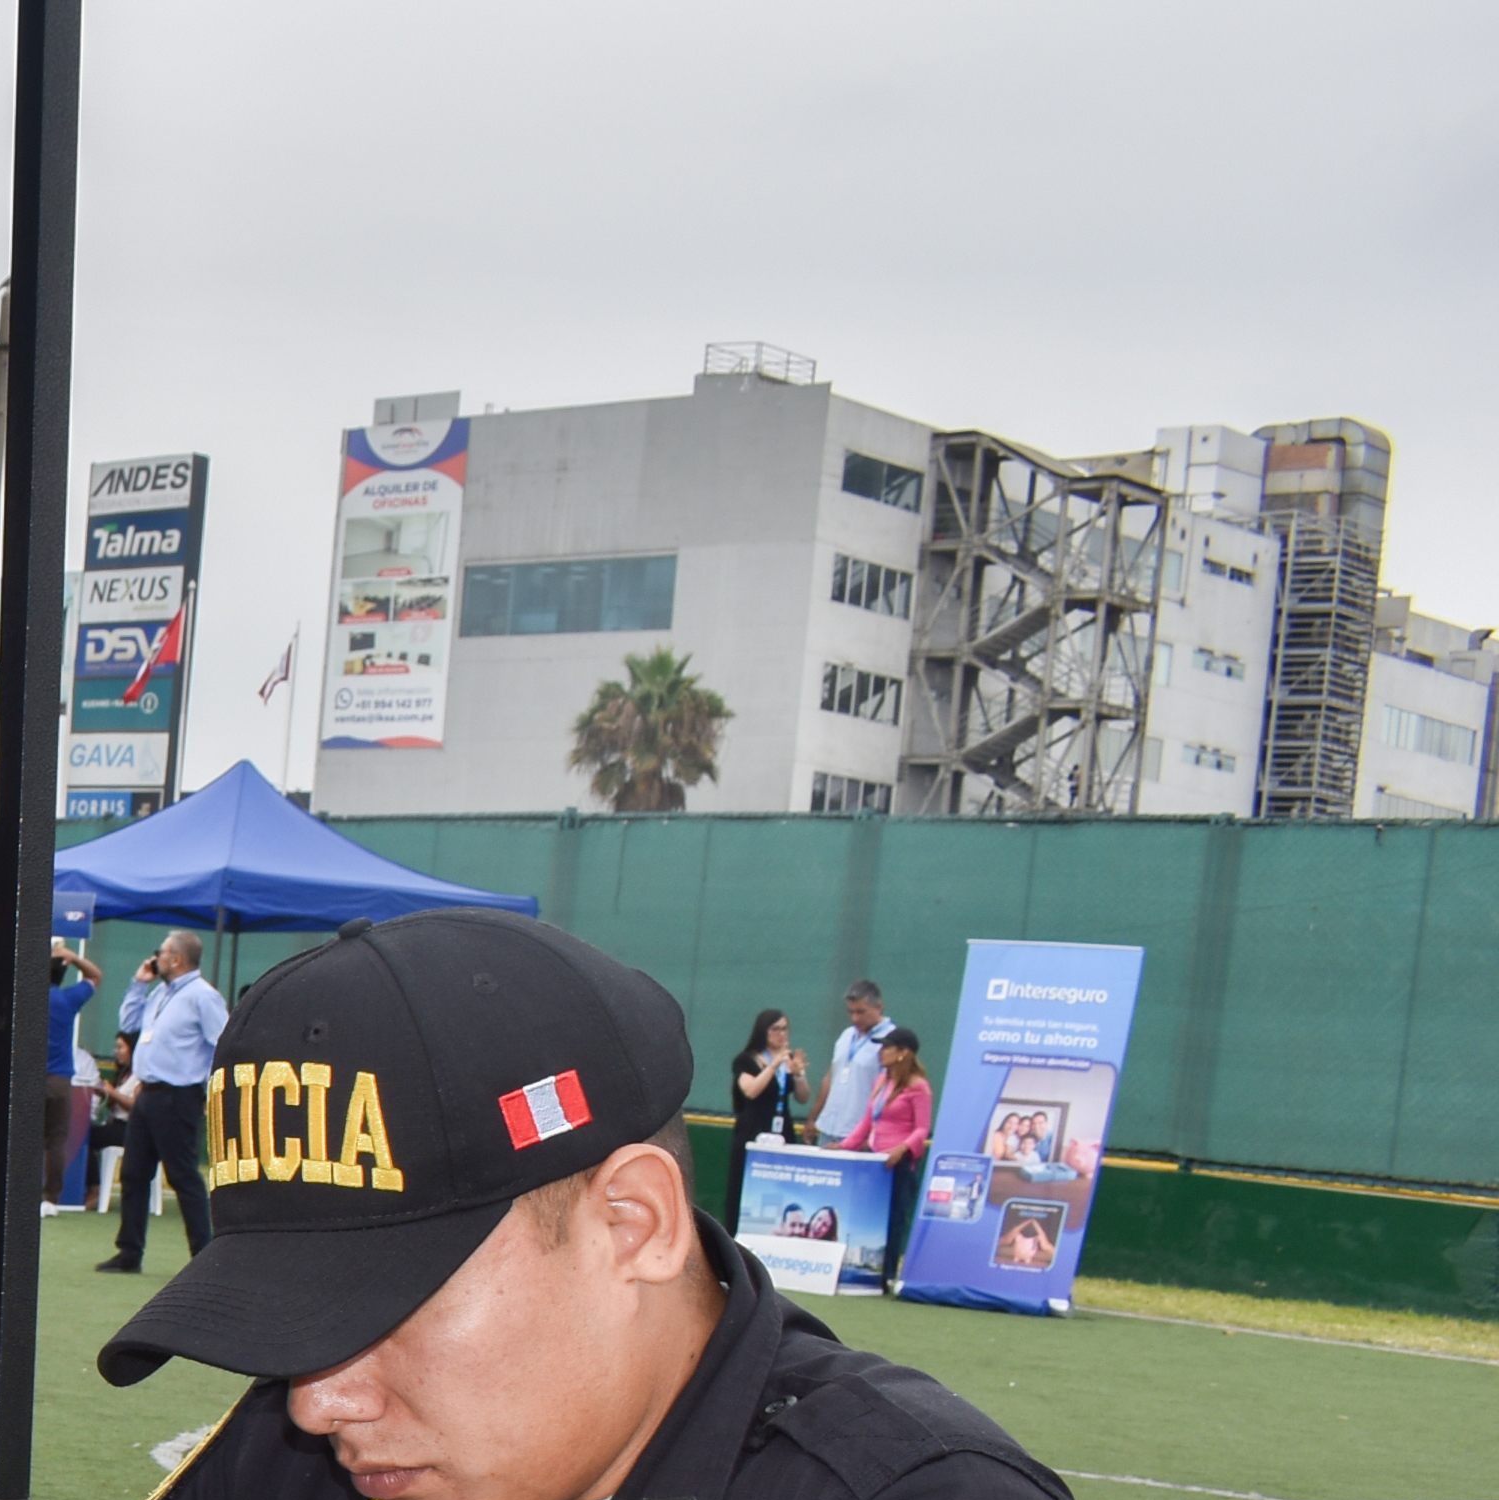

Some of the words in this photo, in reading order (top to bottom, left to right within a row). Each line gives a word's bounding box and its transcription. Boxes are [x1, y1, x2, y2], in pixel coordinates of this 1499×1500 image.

[92, 462, 190, 497] ANDES
[363, 482, 420, 497] ALQUILER
[423, 480, 438, 491] DE
[372, 496, 428, 510] OFICINAS
[93, 524, 181, 559] Talma
[89, 575, 171, 604] NEXUS
[85, 627, 166, 663] DSV
[69, 744, 135, 768] GAVA
[1009, 981, 1108, 1004] Interseguro
[979, 1030, 1021, 1043] como
[1024, 1031, 1040, 1045] tu
[1043, 1032, 1098, 1048] ahorro
[795, 1172, 841, 1187] seguras
